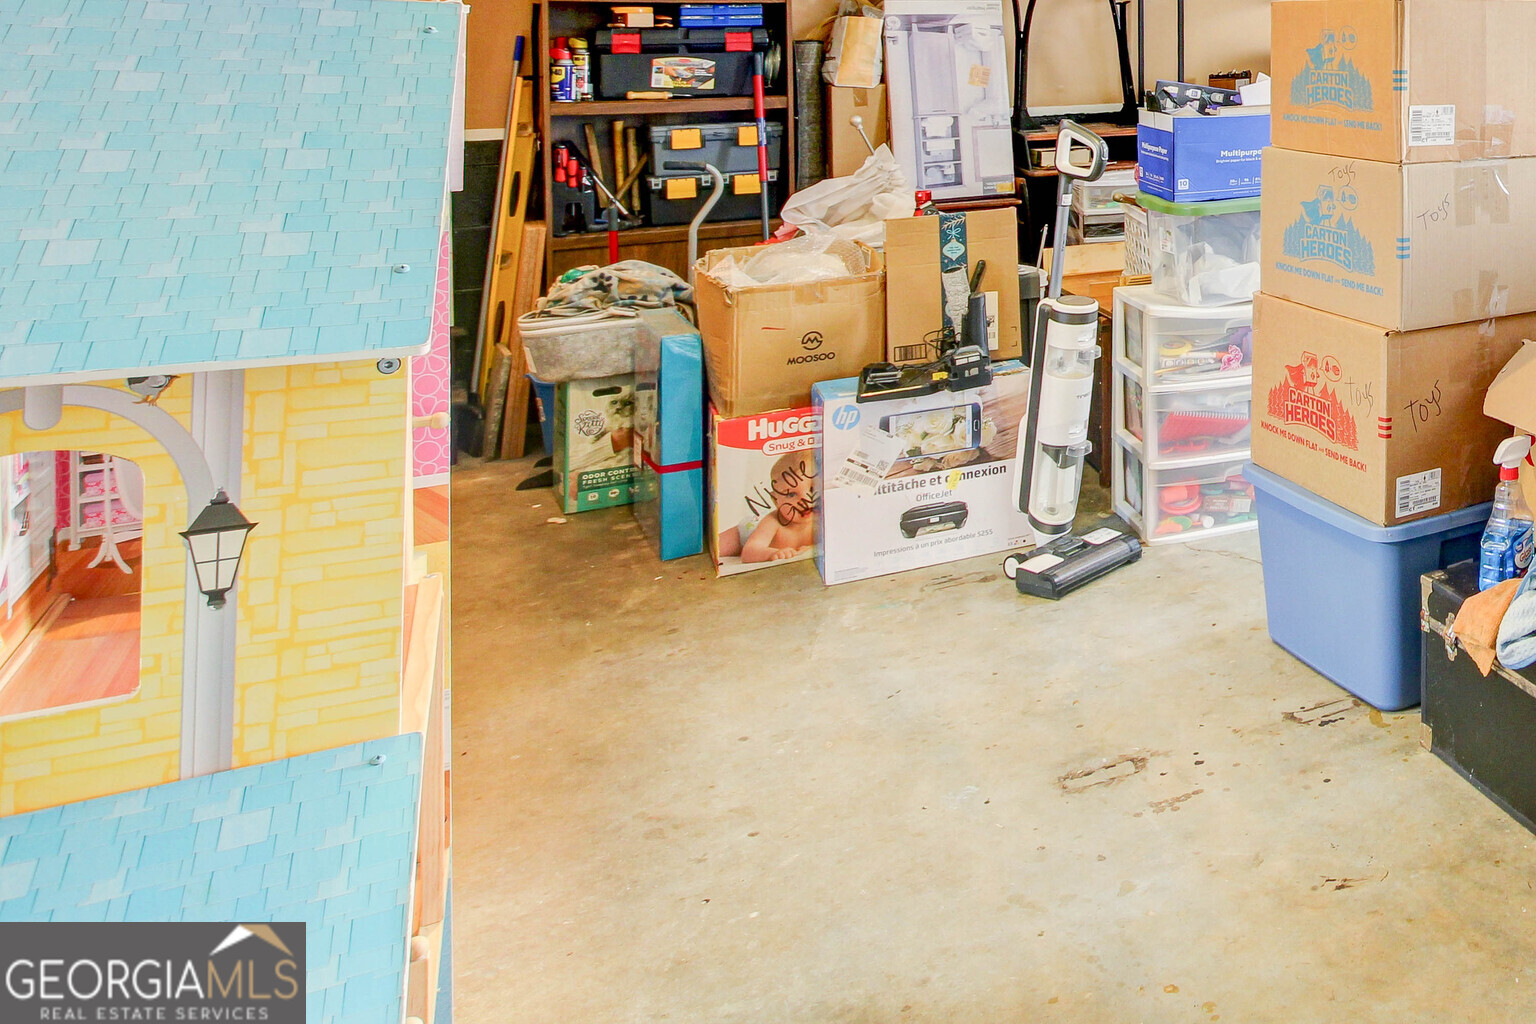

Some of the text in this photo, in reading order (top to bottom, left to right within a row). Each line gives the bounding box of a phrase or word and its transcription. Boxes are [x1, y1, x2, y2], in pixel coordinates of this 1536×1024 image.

[1309, 71, 1349, 88] CARTON
[1306, 85, 1353, 110] HEROES
[1220, 148, 1262, 158] Multipurpo
[1304, 225, 1347, 247] CARTON
[1301, 239, 1352, 270] HEROES
[1275, 261, 1294, 273] KNOCK
[1294, 266, 1302, 276] ME
[1302, 268, 1320, 280] DOWN
[1321, 273, 1334, 283] FLAT
[1341, 278, 1356, 289] SEND
[1356, 282, 1365, 292] ME
[1366, 285, 1384, 296] BACK!
[786, 351, 836, 366] MOOSOO
[1289, 388, 1332, 416] CARTON
[1403, 379, 1442, 433] Toys
[835, 405, 860, 430] hp
[1285, 402, 1336, 443] HEROES
[768, 439, 796, 452] Snug
[797, 438, 806, 446] &
[1260, 420, 1279, 435] KNOCK
[1279, 428, 1287, 439] ME
[1288, 431, 1305, 446] DOWN
[1305, 439, 1318, 451] FLAT
[1325, 447, 1339, 461] SEND
[1340, 453, 1348, 465] ME
[1349, 458, 1367, 472] BACK!
[582, 471, 606, 480] ODOR
[582, 477, 608, 485] FRESH
[874, 464, 1007, 496] ltitâche et cnnexion
[916, 489, 953, 502] OfficeJet
[874, 545, 915, 557] Impressions
[930, 539, 943, 548] prix
[944, 532, 976, 544] abordable
[977, 528, 994, 537] 5255
